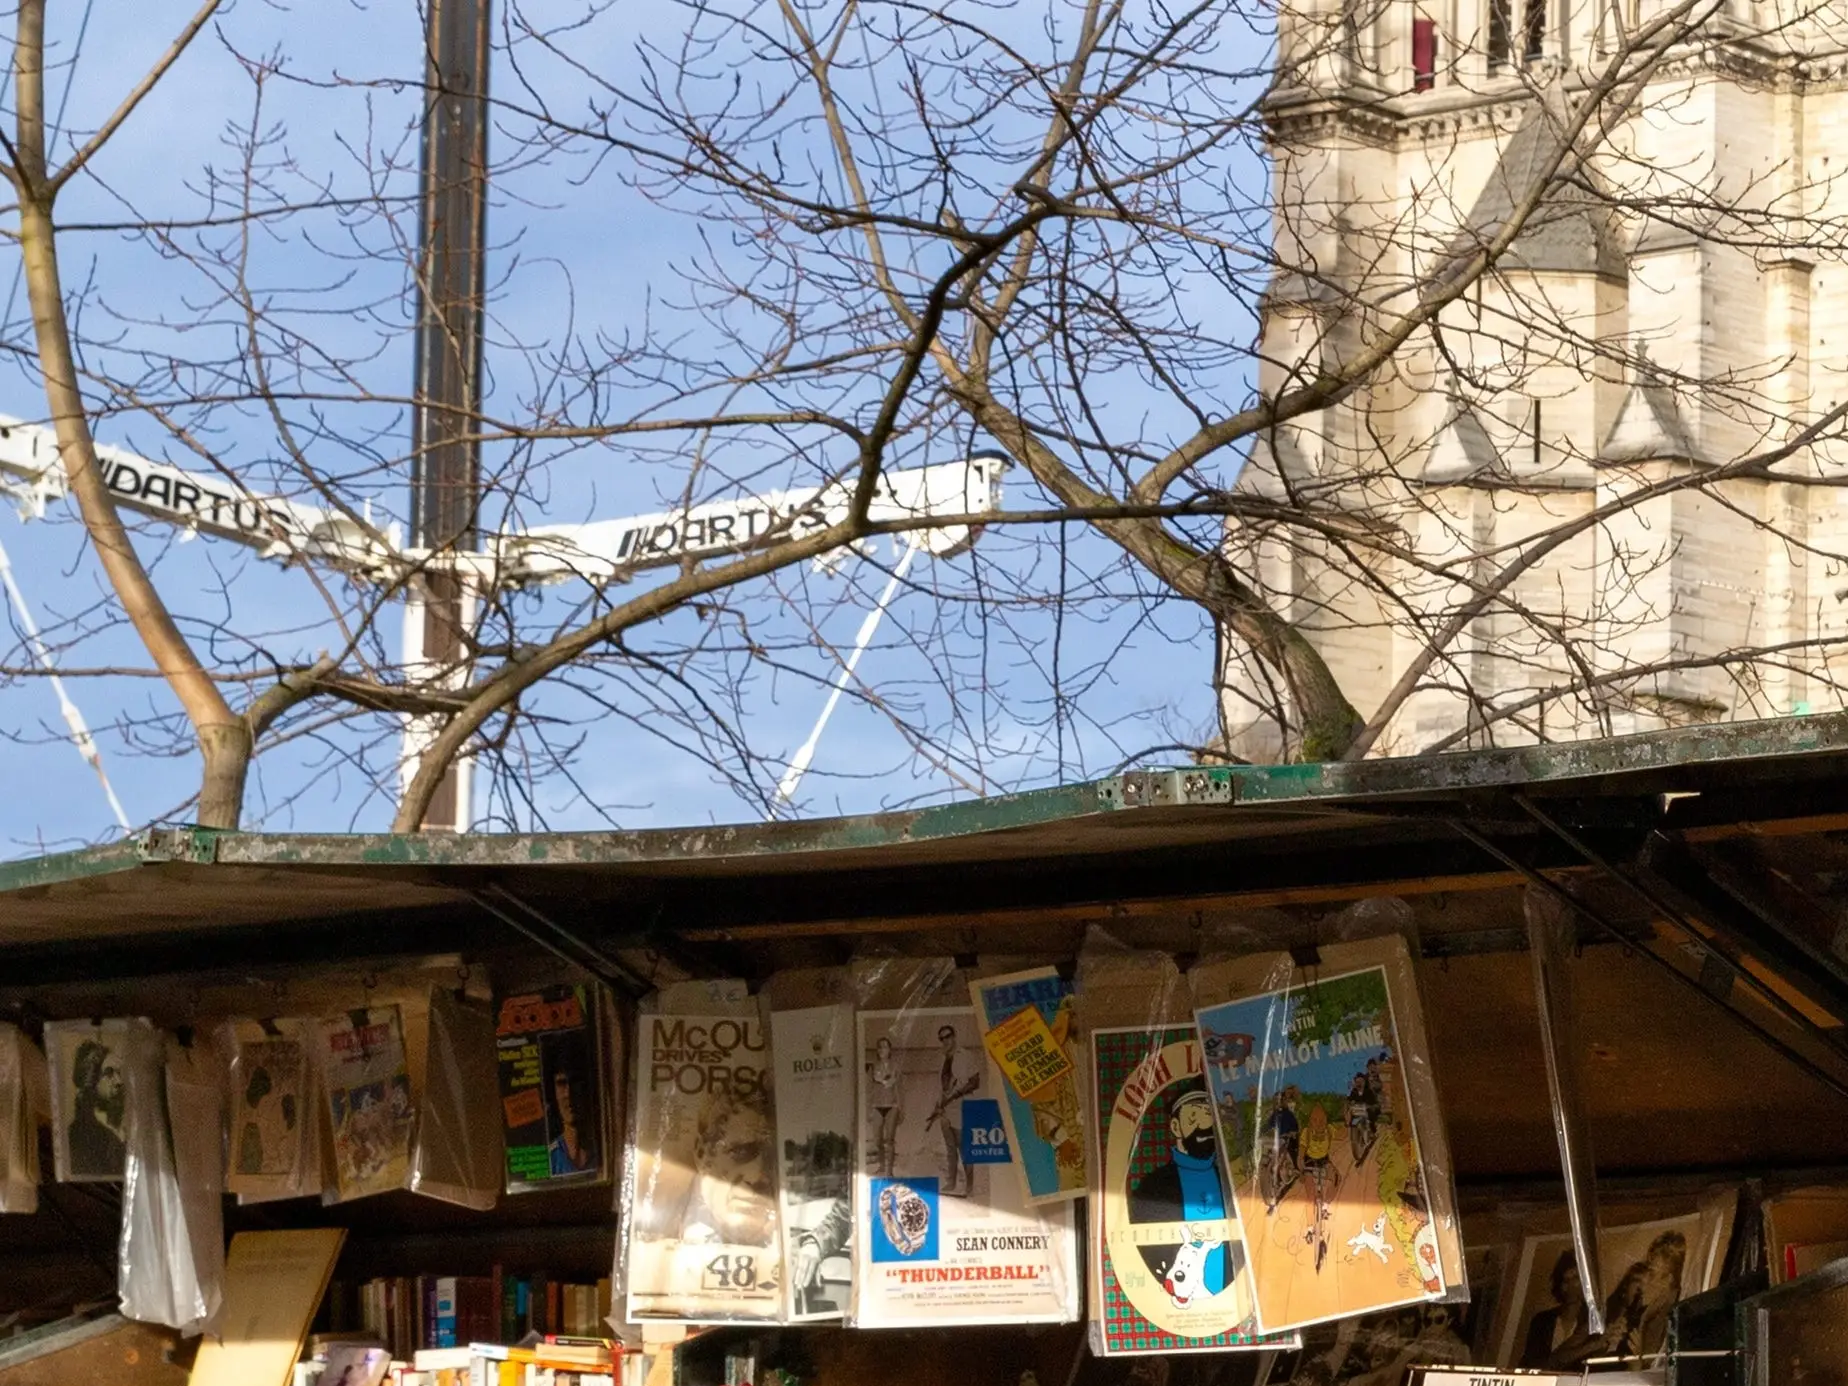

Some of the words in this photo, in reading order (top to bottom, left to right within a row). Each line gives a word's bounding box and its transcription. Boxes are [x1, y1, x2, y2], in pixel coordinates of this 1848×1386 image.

[793, 1055, 843, 1074] ROLEX
[1218, 1060, 1239, 1083] LE
[1328, 1024, 1386, 1058] JAUNE
[956, 1235, 988, 1251] SEAN
[991, 1234, 1051, 1251] CONNERY
[706, 1254, 757, 1287] 48
